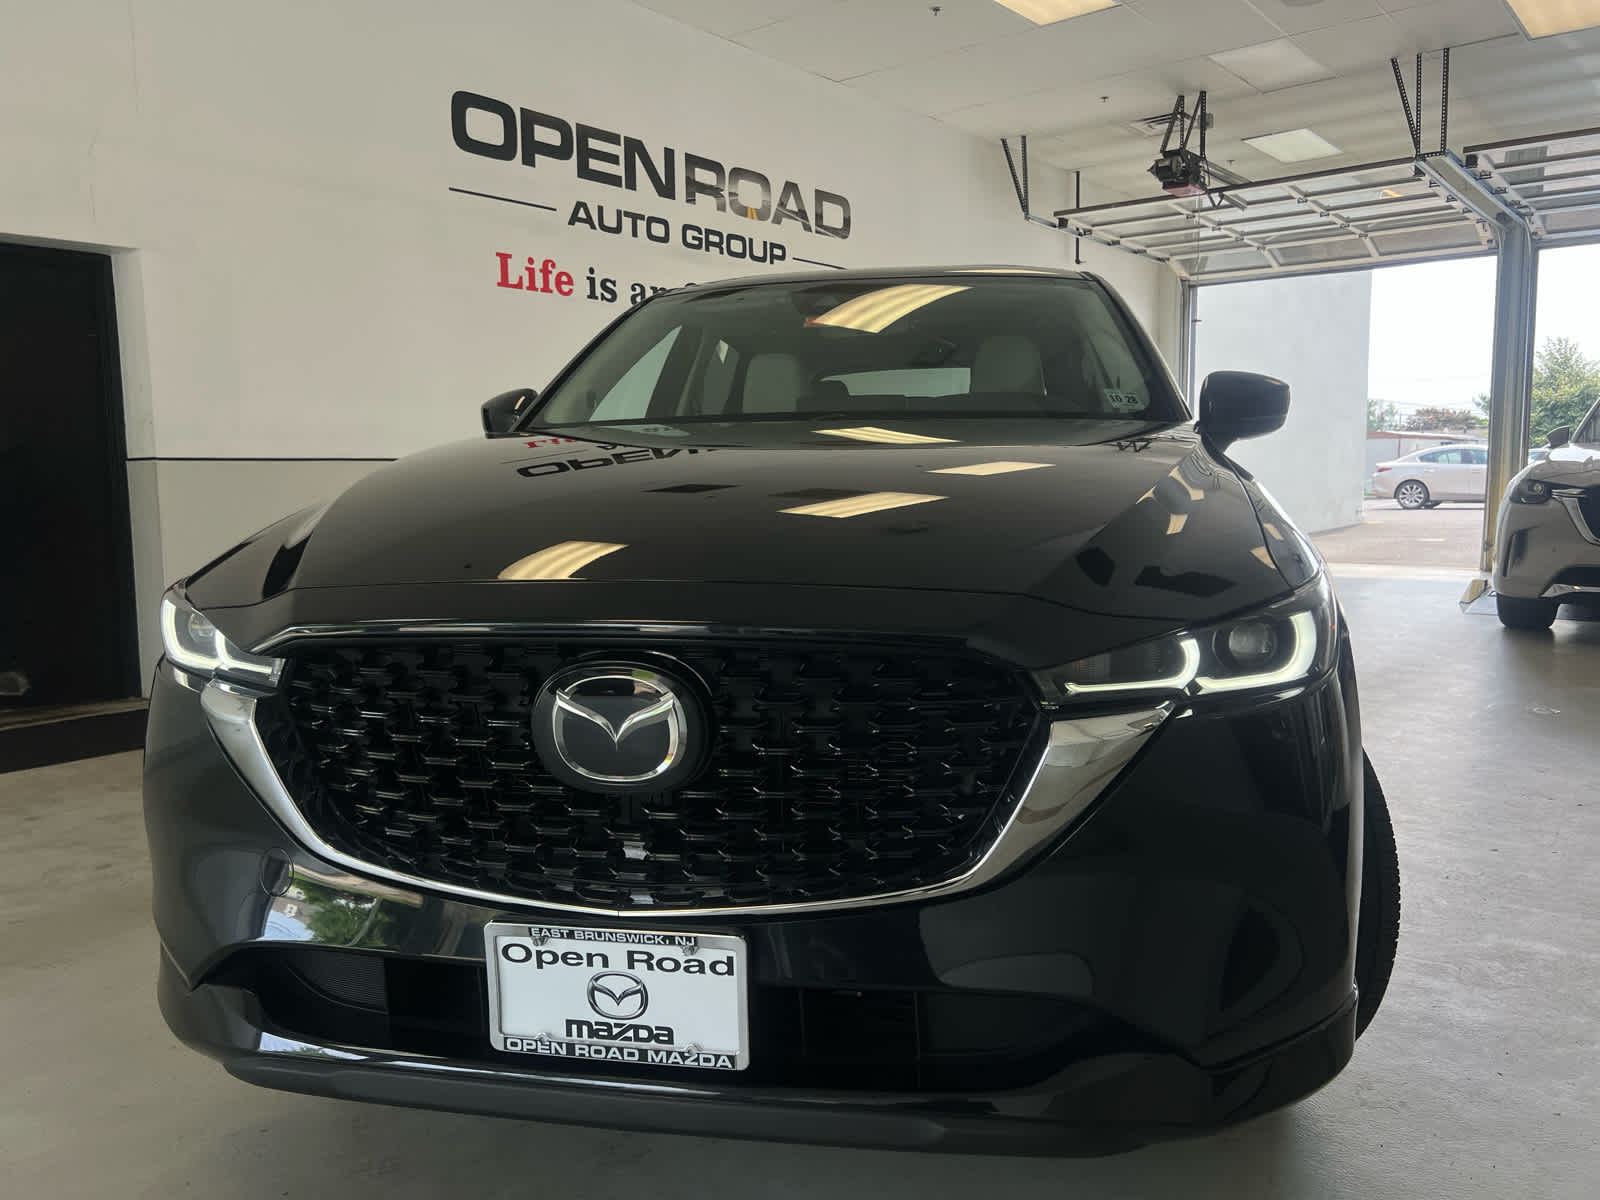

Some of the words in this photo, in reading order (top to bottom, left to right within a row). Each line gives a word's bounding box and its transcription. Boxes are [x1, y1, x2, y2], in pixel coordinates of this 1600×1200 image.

[451, 90, 676, 200] OPEN
[684, 152, 852, 240] ROAD
[568, 201, 671, 244] AUTO
[682, 223, 787, 265] GROUP
[496, 251, 574, 297] Life
[586, 267, 617, 304] is
[531, 927, 570, 939] EAST
[675, 936, 695, 947] NJ
[501, 943, 609, 970] Open
[626, 949, 735, 976] Road
[506, 1037, 567, 1056] OPEN
[574, 1044, 639, 1062] ROAD
[647, 1050, 733, 1069] MAZDA
